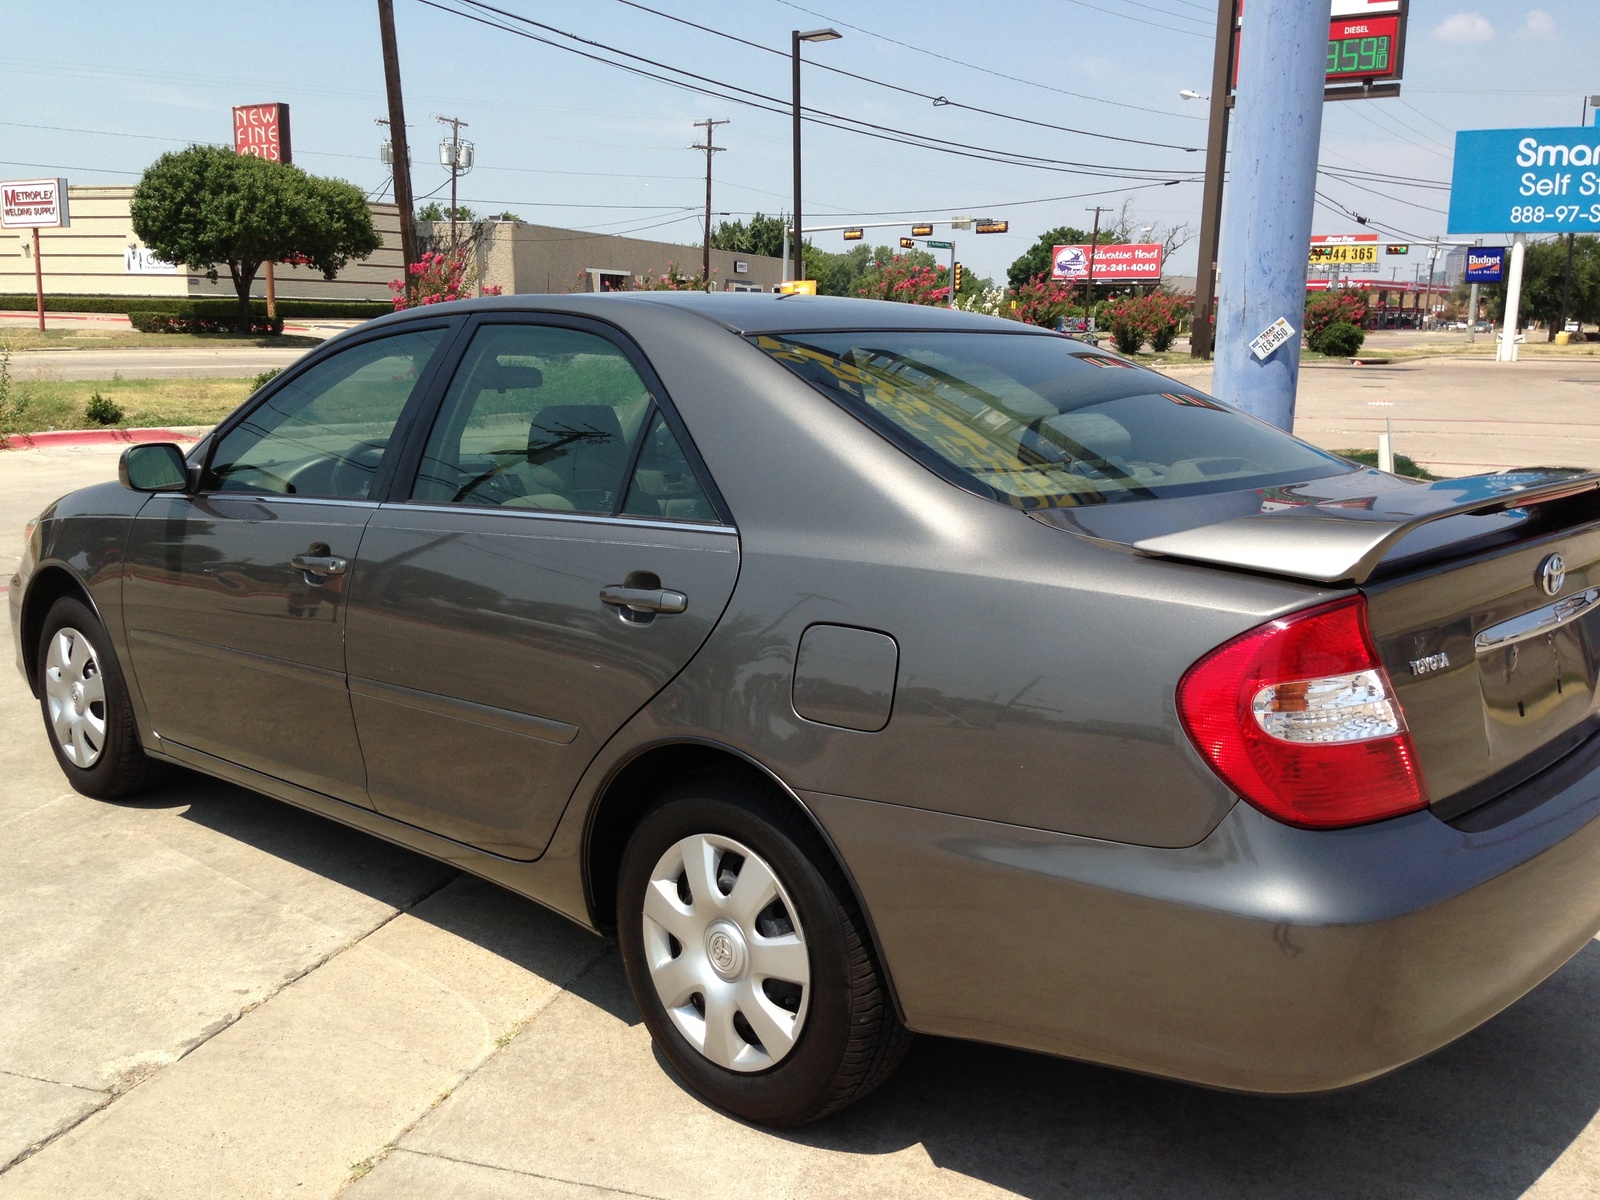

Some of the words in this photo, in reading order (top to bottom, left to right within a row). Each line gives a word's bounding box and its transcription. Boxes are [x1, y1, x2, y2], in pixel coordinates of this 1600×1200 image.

[1344, 25, 1369, 34] DIESEL
[236, 107, 276, 126] NEW
[237, 125, 277, 144] FINE
[240, 144, 278, 161] ARTS
[1519, 172, 1571, 196] Self
[4, 189, 54, 207] METROPLEX
[5, 208, 32, 217] WELDING
[33, 206, 55, 216] SUPPLY
[1134, 248, 1159, 259] Here!
[1351, 247, 1373, 260] 365
[1468, 254, 1501, 266] Budget
[1259, 325, 1276, 340] TEXAS
[1409, 652, 1450, 676] TOYOTA
